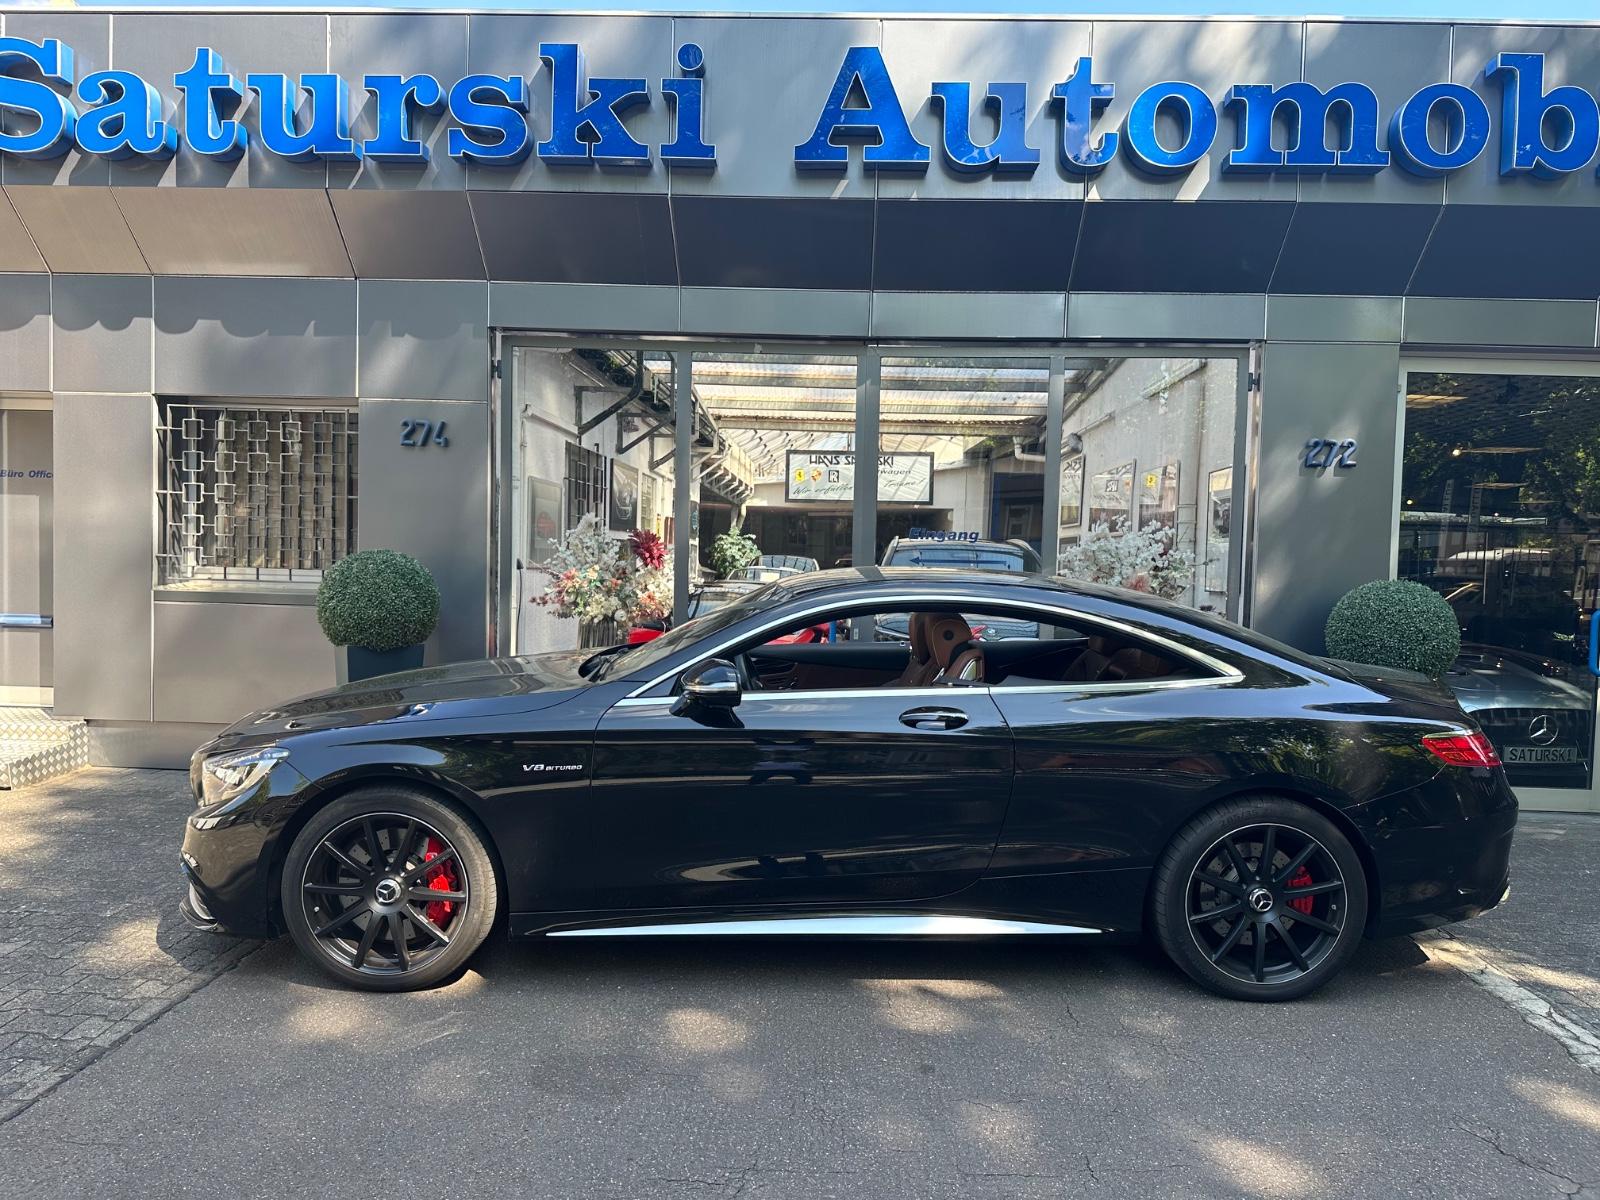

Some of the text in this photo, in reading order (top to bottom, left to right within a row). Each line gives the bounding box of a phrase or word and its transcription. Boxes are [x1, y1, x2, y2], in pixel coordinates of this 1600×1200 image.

[0, 36, 1600, 179] Saturski Automob
[400, 417, 449, 447] 274
[1305, 438, 1357, 468] 272
[809, 455, 840, 468] HANS
[0, 469, 24, 478] Büro
[909, 527, 979, 543] Eingang
[1509, 748, 1572, 762] SATURSKI
